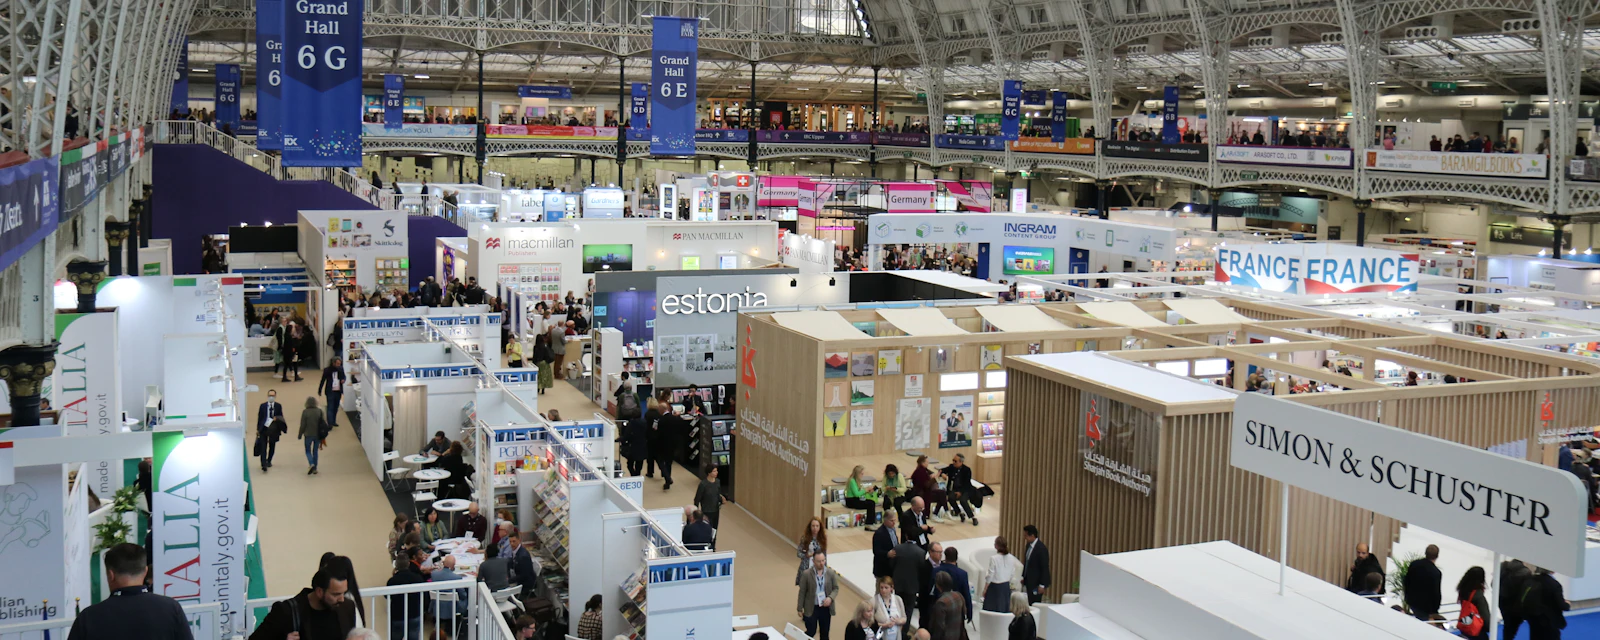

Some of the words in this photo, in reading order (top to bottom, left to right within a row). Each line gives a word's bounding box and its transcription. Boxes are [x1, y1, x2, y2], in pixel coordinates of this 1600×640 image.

[296, 0, 348, 15] Grand
[305, 20, 339, 35] Hall
[266, 40, 282, 50] Gra
[297, 45, 316, 69] 6
[324, 45, 347, 70] G
[660, 56, 689, 65] Grand
[268, 70, 281, 86] 6
[665, 68, 684, 77] Hall
[661, 82, 672, 98] 6
[676, 83, 687, 98] E
[220, 94, 227, 102] 6
[228, 94, 235, 102] G
[1005, 108, 1012, 116] 6
[1011, 108, 1017, 116] C
[1530, 108, 1541, 116] Lift
[1254, 151, 1276, 159] ARASOFT
[1441, 155, 1522, 174] BARAMGILBOOKS
[521, 197, 542, 207] fabe
[891, 195, 927, 206] Germany
[1004, 222, 1057, 234] INGRAM
[508, 237, 574, 249] macmillan
[682, 232, 697, 241] PAN
[698, 232, 744, 241] MACMILLAN
[1510, 232, 1523, 241] Lift
[789, 247, 799, 260] PAN
[800, 249, 829, 266] MACMILLAN
[1218, 249, 1300, 282] FRANCE
[1307, 257, 1410, 284] FRANCE
[661, 285, 768, 315] estonia
[352, 330, 404, 338] LLEWELLYN
[62, 342, 88, 436] TALIA
[740, 407, 761, 428] للكتاب
[761, 417, 788, 441] الشارقة
[740, 422, 761, 447] Sharjah
[761, 434, 777, 456] Book
[777, 444, 809, 476] Authority
[788, 432, 810, 454] هيئة
[499, 445, 533, 458] PGUK
[1084, 451, 1105, 465] للكتاب
[1104, 458, 1131, 475] الشارقة
[1083, 460, 1106, 476] Sharjah
[1105, 469, 1121, 483] Book
[1120, 475, 1151, 497] Authority
[1131, 469, 1152, 484] هيئة
[1245, 420, 1334, 469] SIMON
[1339, 447, 1364, 478] &
[1370, 455, 1553, 536] SCHUSTER
[619, 481, 642, 490] 6E30
